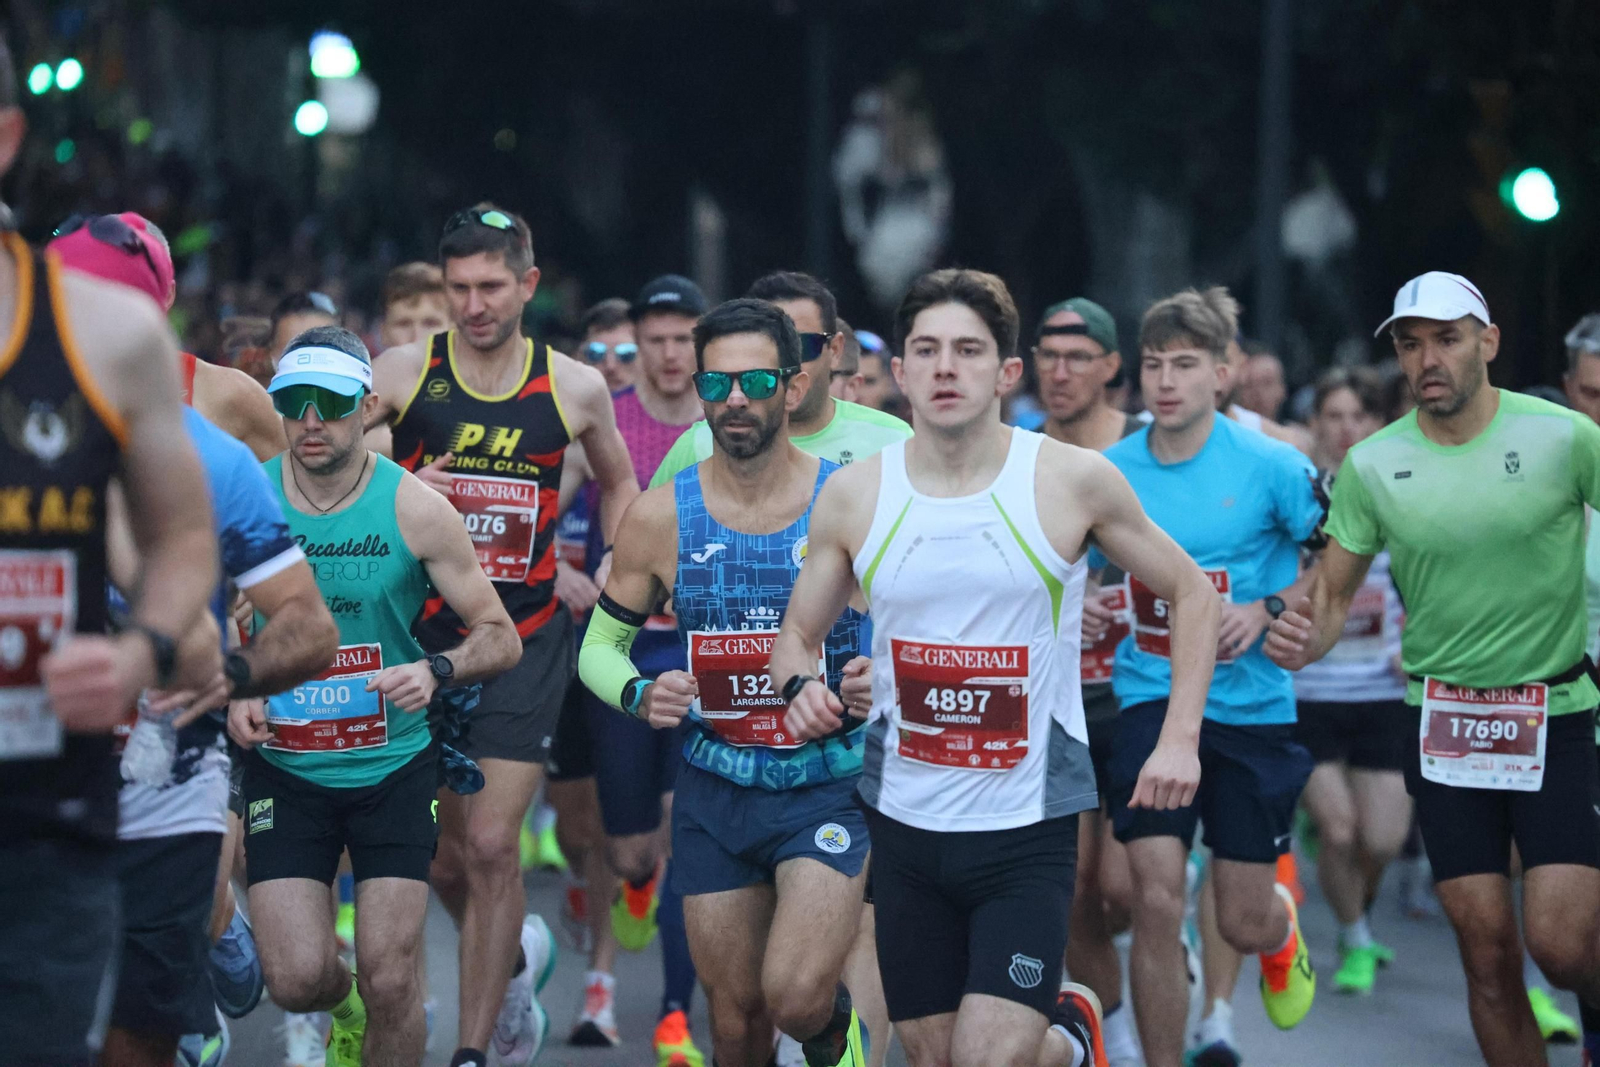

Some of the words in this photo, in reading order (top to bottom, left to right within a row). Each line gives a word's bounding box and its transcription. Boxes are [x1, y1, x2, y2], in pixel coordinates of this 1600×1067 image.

[423, 454, 489, 469] RCING
[456, 481, 529, 502] GENERALI
[461, 513, 506, 534] 076
[725, 638, 777, 654] GENE
[924, 648, 1020, 669] GENERALI
[728, 674, 774, 696] 132
[293, 686, 350, 705] 5700
[731, 697, 787, 706] LARGARSSO
[924, 687, 991, 713] 4897
[305, 707, 341, 715] CORBERI
[934, 713, 981, 724] CAMERON
[346, 723, 369, 732] 42K
[1450, 717, 1519, 740] 17690
[983, 741, 1009, 750] 42K
[1470, 740, 1494, 749] FABIO
